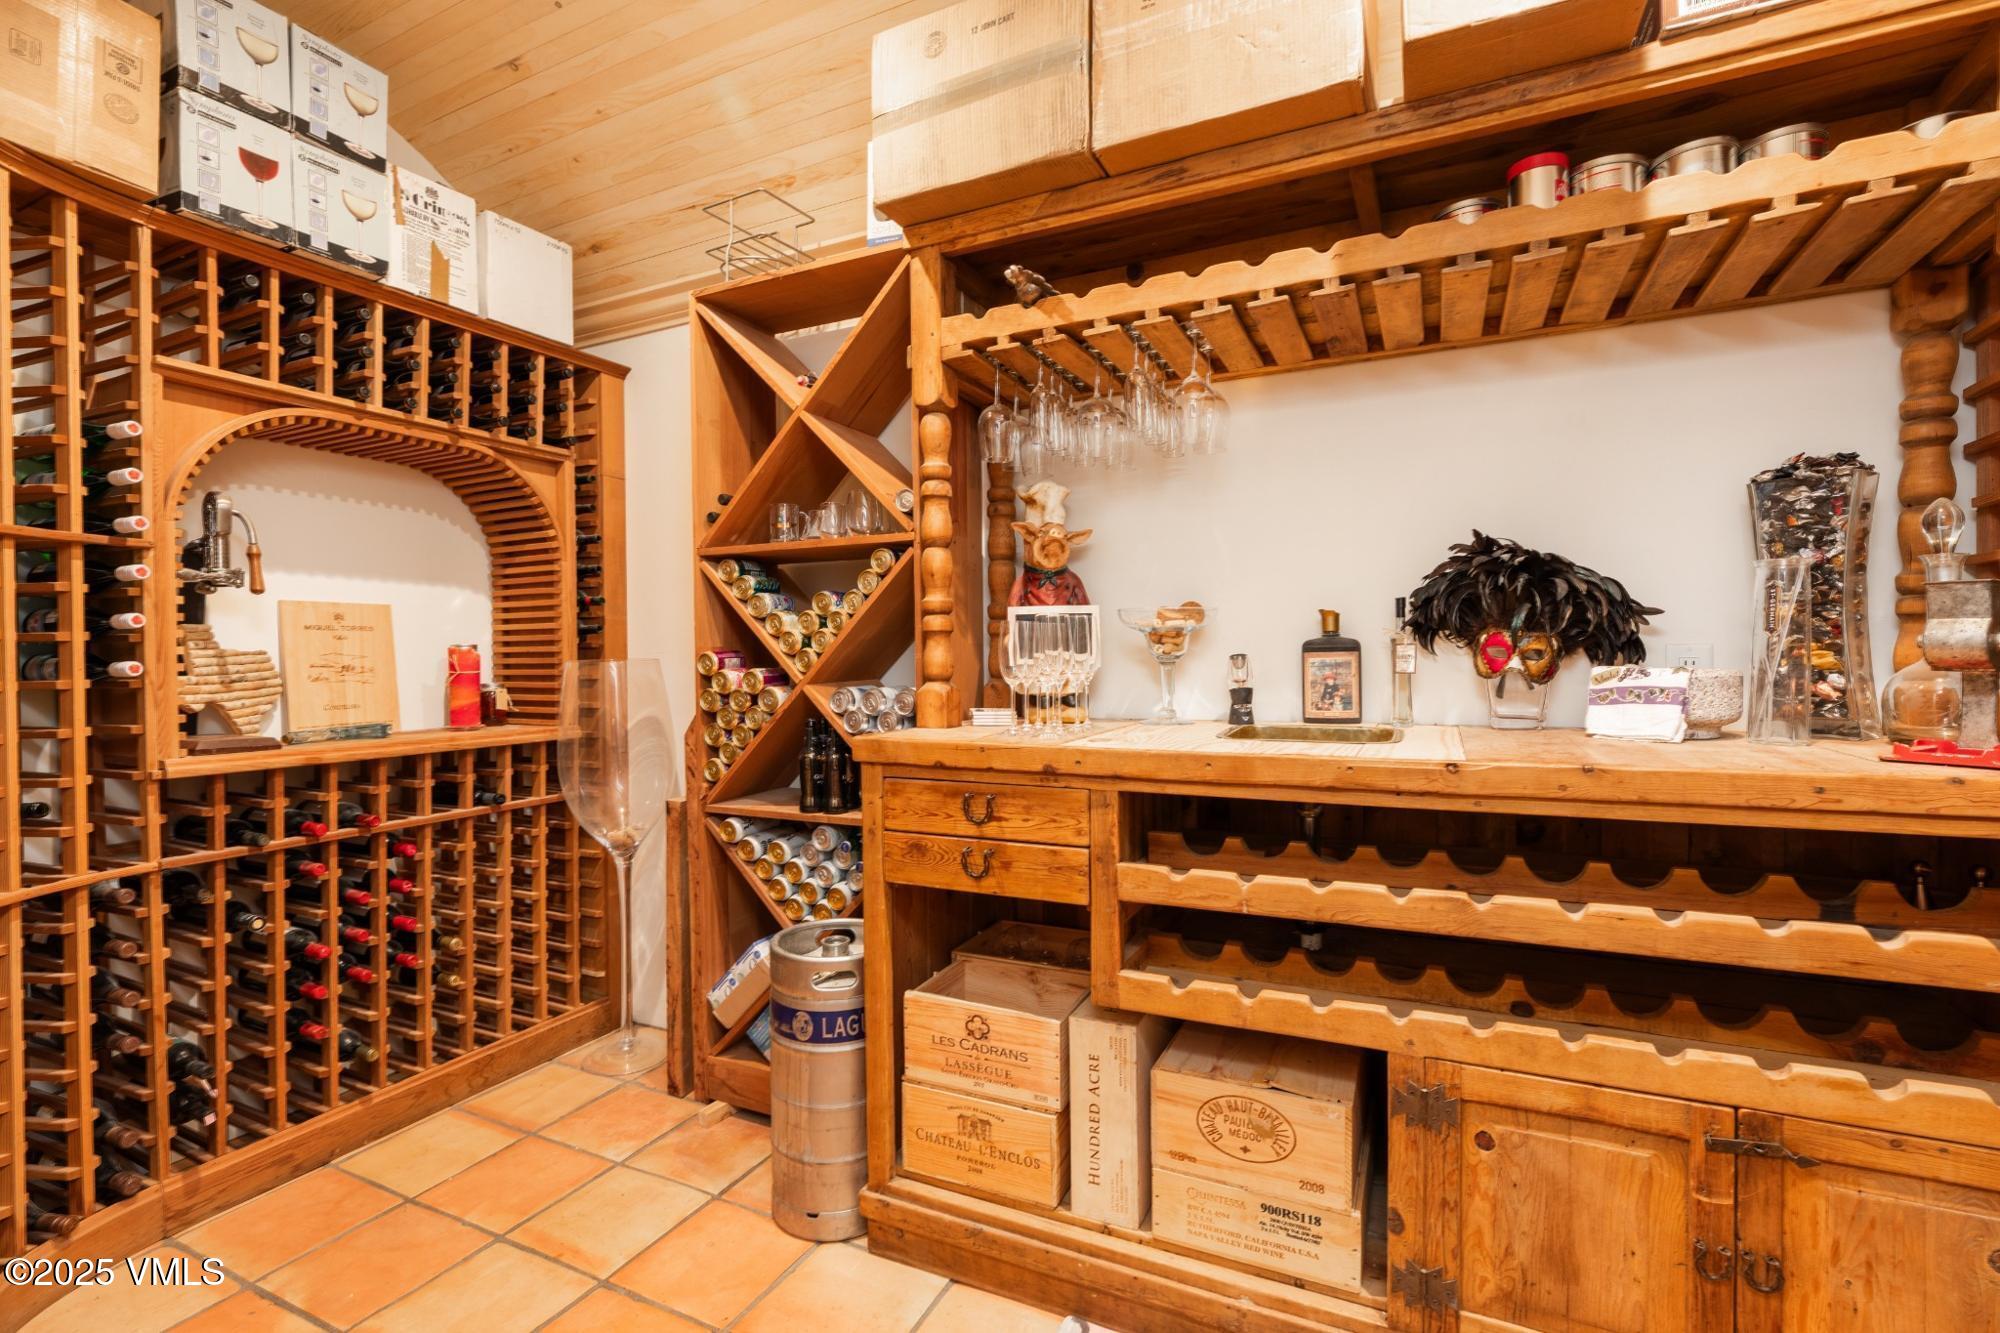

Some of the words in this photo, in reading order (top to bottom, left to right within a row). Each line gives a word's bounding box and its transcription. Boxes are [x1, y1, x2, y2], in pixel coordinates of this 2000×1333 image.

[821, 1013, 864, 1039] LAG
[931, 1034, 956, 1048] LES
[959, 1038, 1029, 1063] CADRANS
[1088, 1053, 1101, 1097] ACRE
[915, 1127, 972, 1153] CHATEAU
[979, 1144, 1041, 1170] L'ENCLOS
[1088, 1103, 1101, 1186] HUNDRED
[1299, 1180, 1326, 1195] 2008
[1260, 1202, 1322, 1227] 900RS118
[1243, 1243, 1261, 1254] RED
[1261, 1247, 1285, 1261] WINE
[1245, 1234, 1297, 1254] CALIFORNIA
